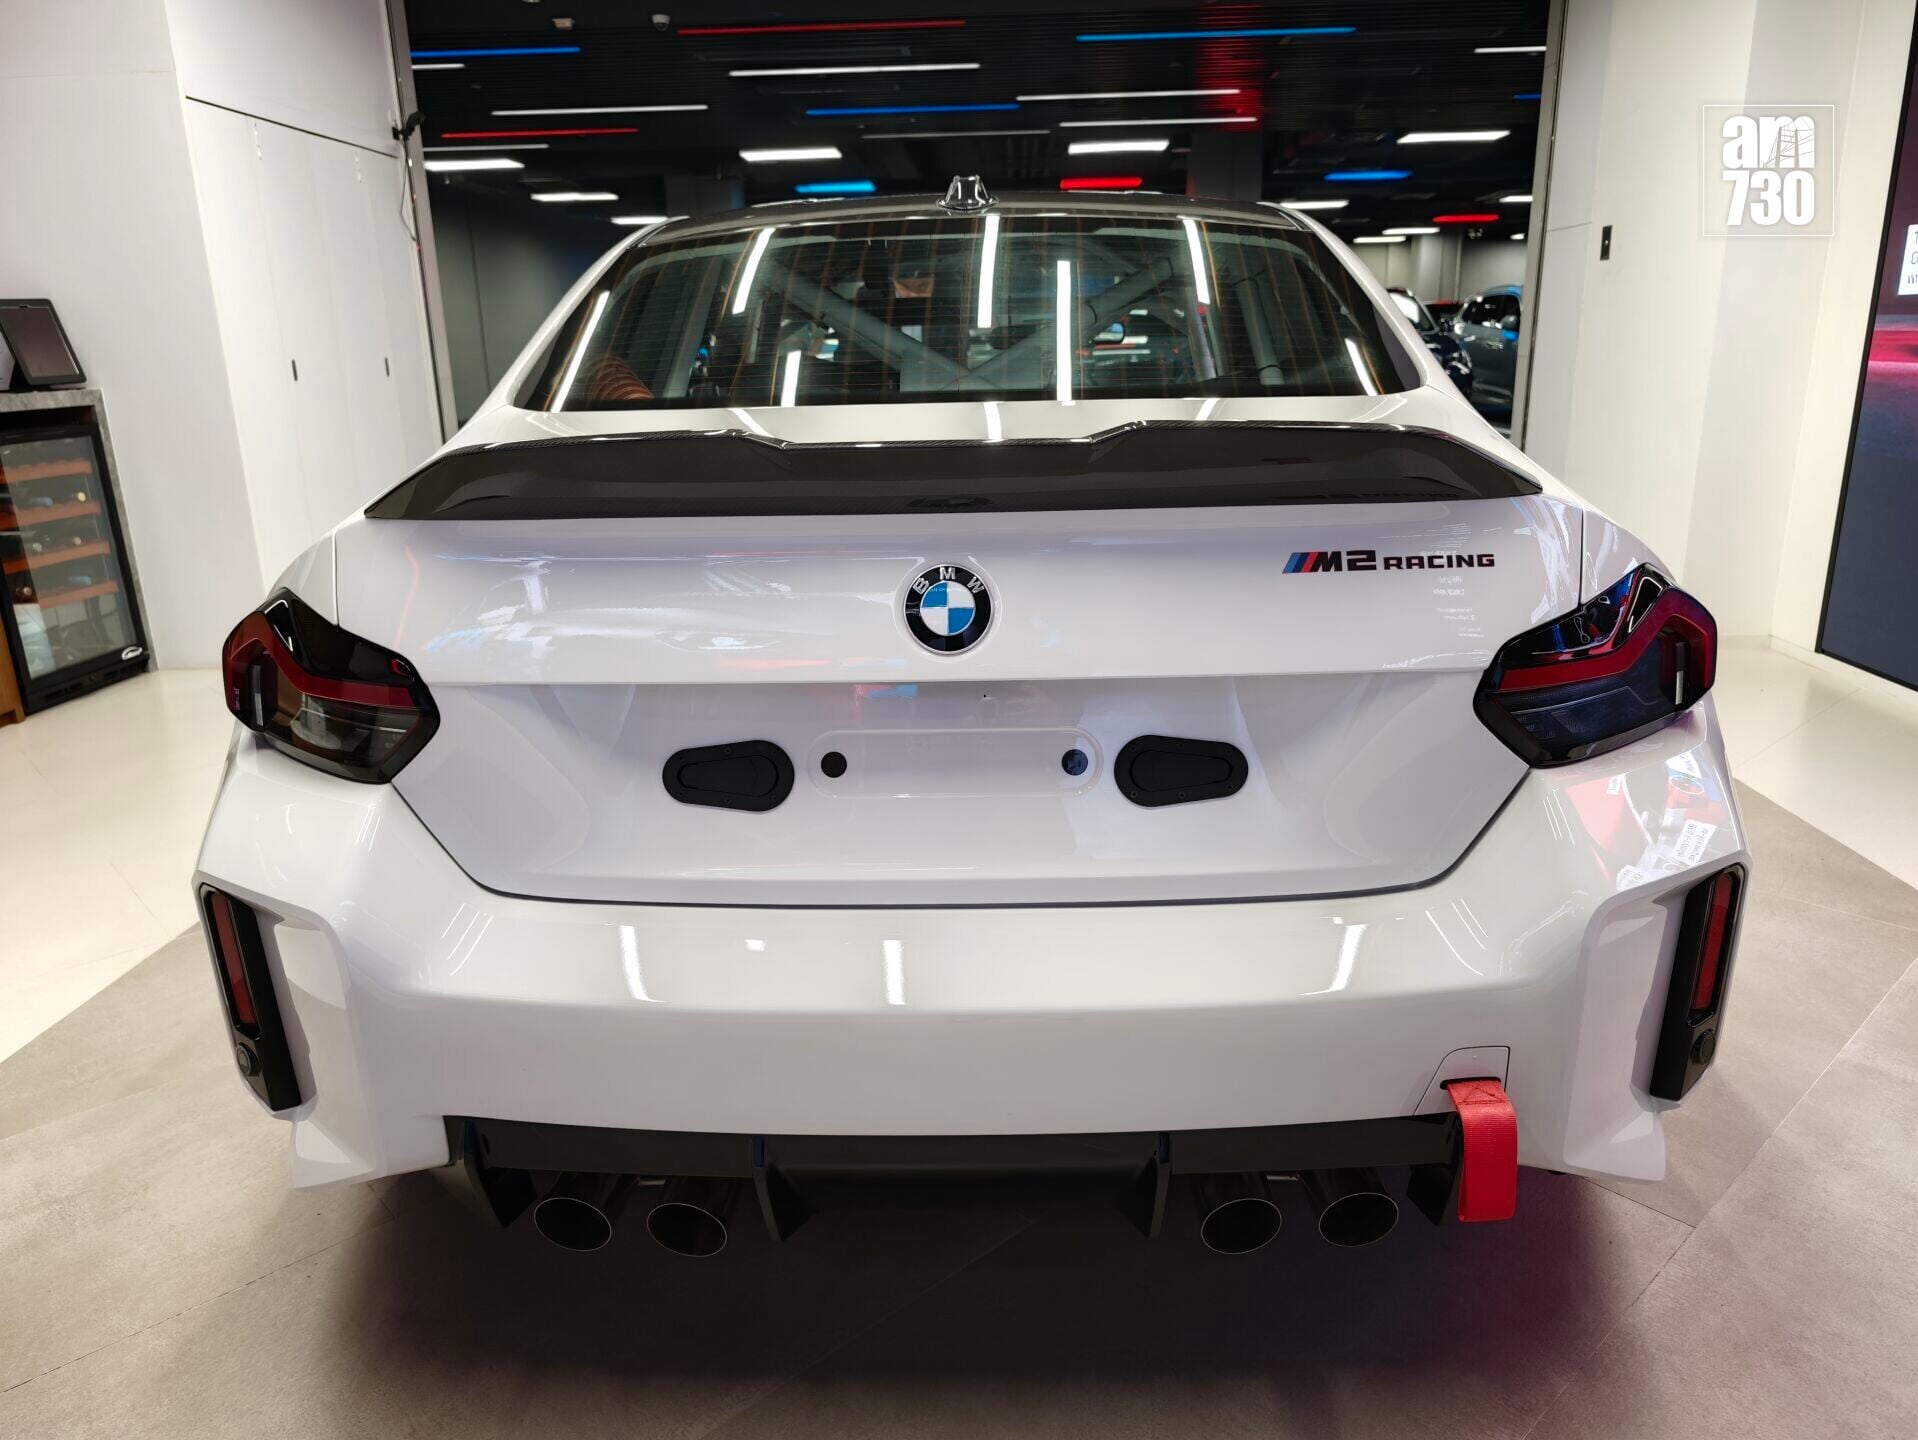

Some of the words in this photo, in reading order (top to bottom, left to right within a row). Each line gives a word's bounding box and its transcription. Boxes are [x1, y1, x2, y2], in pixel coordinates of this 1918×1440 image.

[1306, 549, 1377, 573] M2
[1383, 554, 1495, 570] RACING
[912, 566, 985, 595] BMW
